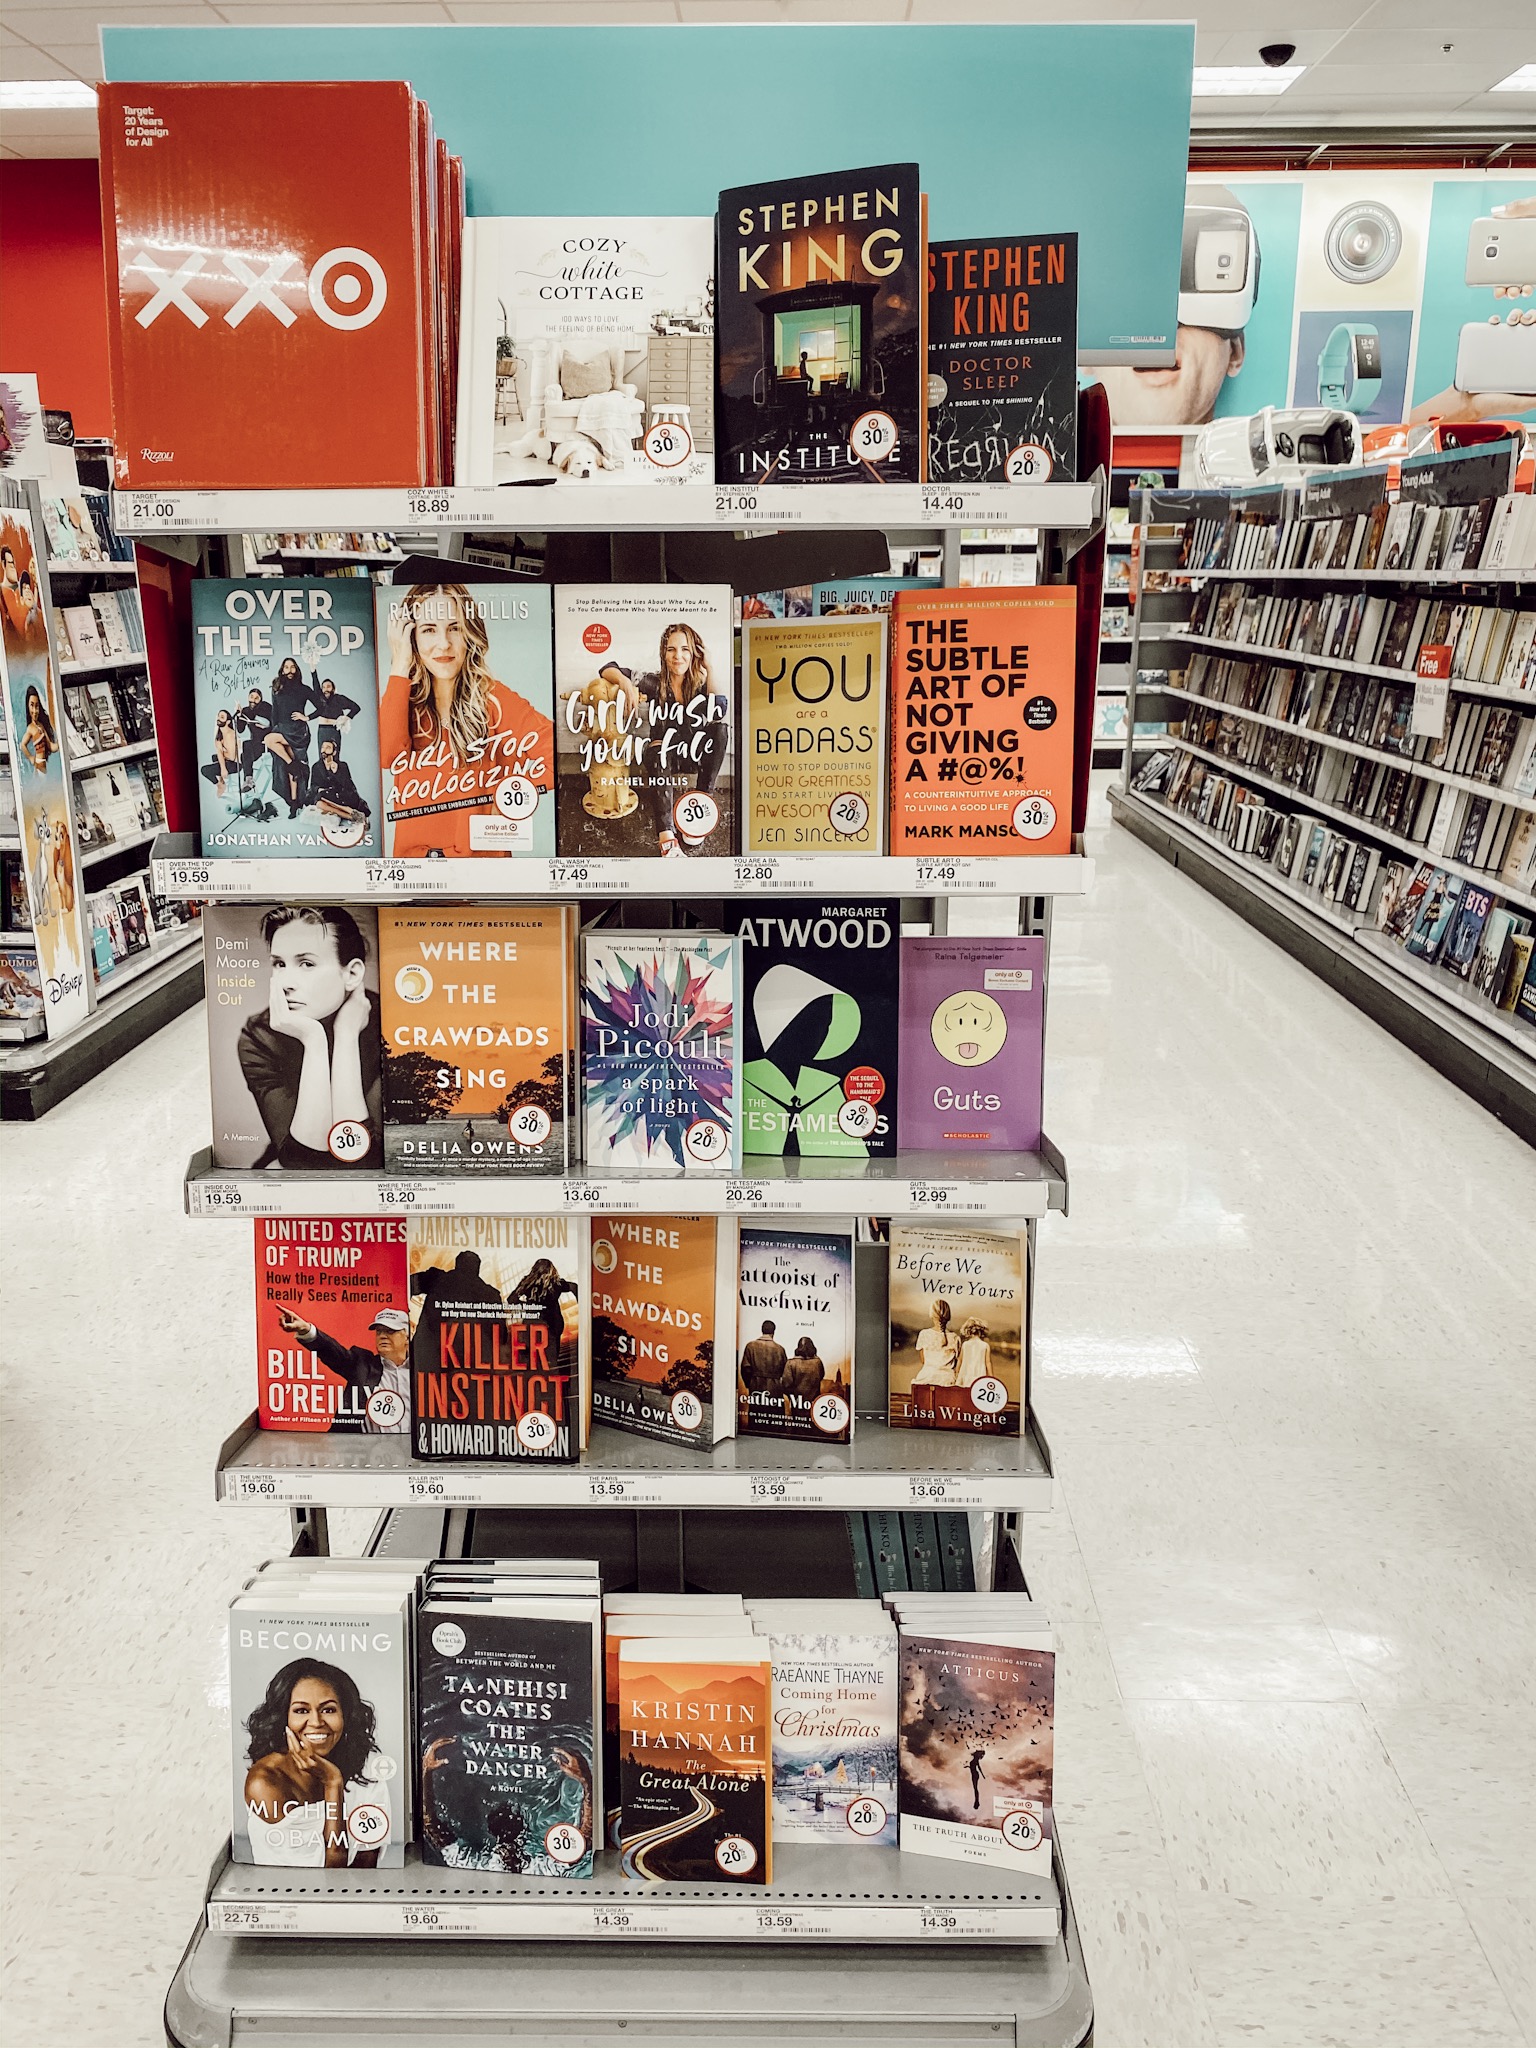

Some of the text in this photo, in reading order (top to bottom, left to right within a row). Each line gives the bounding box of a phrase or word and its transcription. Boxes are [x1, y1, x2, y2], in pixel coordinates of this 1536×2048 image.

[122, 105, 155, 116] Target:
[125, 117, 163, 126] 20 Years
[125, 127, 169, 138] of Design
[125, 138, 153, 147] for All
[738, 187, 899, 236] STEPHEN
[562, 238, 627, 254] COZY
[535, 254, 648, 281] white
[739, 228, 904, 292] KING
[539, 286, 644, 300] COTTAGE
[561, 315, 618, 323] 100 WAYS TO LOVE
[953, 292, 1030, 336] KING
[949, 355, 1032, 374] DOCTOR
[962, 375, 1019, 391] SLEEP
[809, 432, 828, 441] THE
[1402, 473, 1434, 488] Young Adult
[133, 504, 174, 517] 21.00
[408, 500, 449, 513] 18.89
[922, 497, 963, 510] 14.40
[225, 589, 333, 620] OVER
[820, 591, 876, 603] BIG. JUICY.
[390, 601, 529, 620] RACHEL HOLLIS
[197, 625, 366, 656] THE TOP
[905, 619, 969, 645] THE
[905, 645, 1029, 673] SUBTLE
[1420, 656, 1438, 675] Free
[756, 653, 872, 704] YOU
[905, 673, 1027, 700] ART OF
[565, 690, 723, 735] Girl, wash
[796, 710, 828, 719] are a
[906, 702, 973, 728] NOT
[579, 727, 714, 772] your face
[905, 728, 1020, 755] GIVING
[390, 728, 539, 776] GIRL, STOP
[757, 763, 778, 771] HOW
[782, 763, 794, 771] TO
[824, 762, 871, 770] DOUBTING
[905, 756, 1025, 786] A #@%!
[386, 756, 547, 805] APOLOGIZING
[601, 777, 688, 786] RACHEL HOLLIS
[913, 790, 1000, 799] COUNTERINTUITIVE
[1002, 789, 1052, 798] APPROACH
[207, 833, 328, 847] JONATHAN VAN
[905, 825, 953, 838] MARK
[171, 871, 209, 882] 19.59
[366, 869, 405, 881] 17.49
[734, 868, 773, 880] 12.80
[917, 868, 955, 880] 17.49
[118, 899, 141, 918] Date
[821, 907, 887, 918] MARGARET
[1465, 890, 1490, 917] BTS
[737, 918, 891, 949] ATWOOD
[215, 937, 249, 951] Demi
[419, 941, 518, 962] WHERE
[216, 955, 260, 969] Moore
[935, 953, 1004, 962] Raina Telgemeier
[217, 974, 256, 988] Inside
[217, 992, 242, 1006] Out
[442, 984, 497, 1004] THE
[628, 1003, 690, 1028] Jodi
[394, 1026, 549, 1047] CRAWDADS
[596, 1029, 727, 1059] Picoult
[436, 1069, 507, 1089] SING
[622, 1075, 699, 1094] a spark
[622, 1098, 699, 1117] of light
[747, 1098, 767, 1108] THE
[933, 1086, 1002, 1112] Guts
[403, 1141, 544, 1154] DELIA OWENS
[205, 1194, 242, 1204] 19.59
[378, 1192, 415, 1202] 18.20
[563, 1190, 600, 1200] 13.60
[726, 1190, 762, 1200] 20.26
[911, 1191, 947, 1201] 12.99
[265, 1220, 407, 1243] UNITED STATES
[415, 1217, 568, 1248] JAMES PATTERSON
[266, 1245, 362, 1268] OF TRUMP
[774, 1256, 791, 1267] The
[896, 1253, 982, 1280] Before We
[740, 1268, 840, 1289] attooist of
[922, 1278, 1015, 1299] Were Yours
[440, 1322, 550, 1371] KILLER
[267, 1349, 325, 1380] BILL
[417, 1372, 570, 1421] INSTINCT
[903, 1404, 1007, 1428] Lisa Wingate
[419, 1422, 494, 1456] & HOWARD
[241, 1483, 275, 1493] 19.60
[409, 1484, 444, 1494] 19.60
[590, 1485, 624, 1495] 13.59
[239, 1629, 392, 1653] BECOMING
[833, 1668, 884, 1684] THAYNE
[940, 1663, 1020, 1684] ATTICUS
[444, 1675, 568, 1700] TA-NEHISI
[780, 1687, 877, 1703] Coming Home
[460, 1698, 552, 1721] COATES
[631, 1700, 756, 1723] KRISTIN
[821, 1705, 837, 1715] for
[487, 1723, 526, 1741] THE
[774, 1707, 881, 1739] Christmas
[471, 1740, 543, 1760] WATER
[631, 1730, 756, 1754] HANNAH
[465, 1759, 547, 1780] DANCER
[686, 1760, 706, 1770] The
[640, 1772, 750, 1793] Great Alone
[913, 1823, 1004, 1844] THE TRUTH ABOUT
[224, 1913, 259, 1923] 22.75
[594, 1916, 629, 1926] 14.39
[756, 1917, 793, 1926] 13.59
